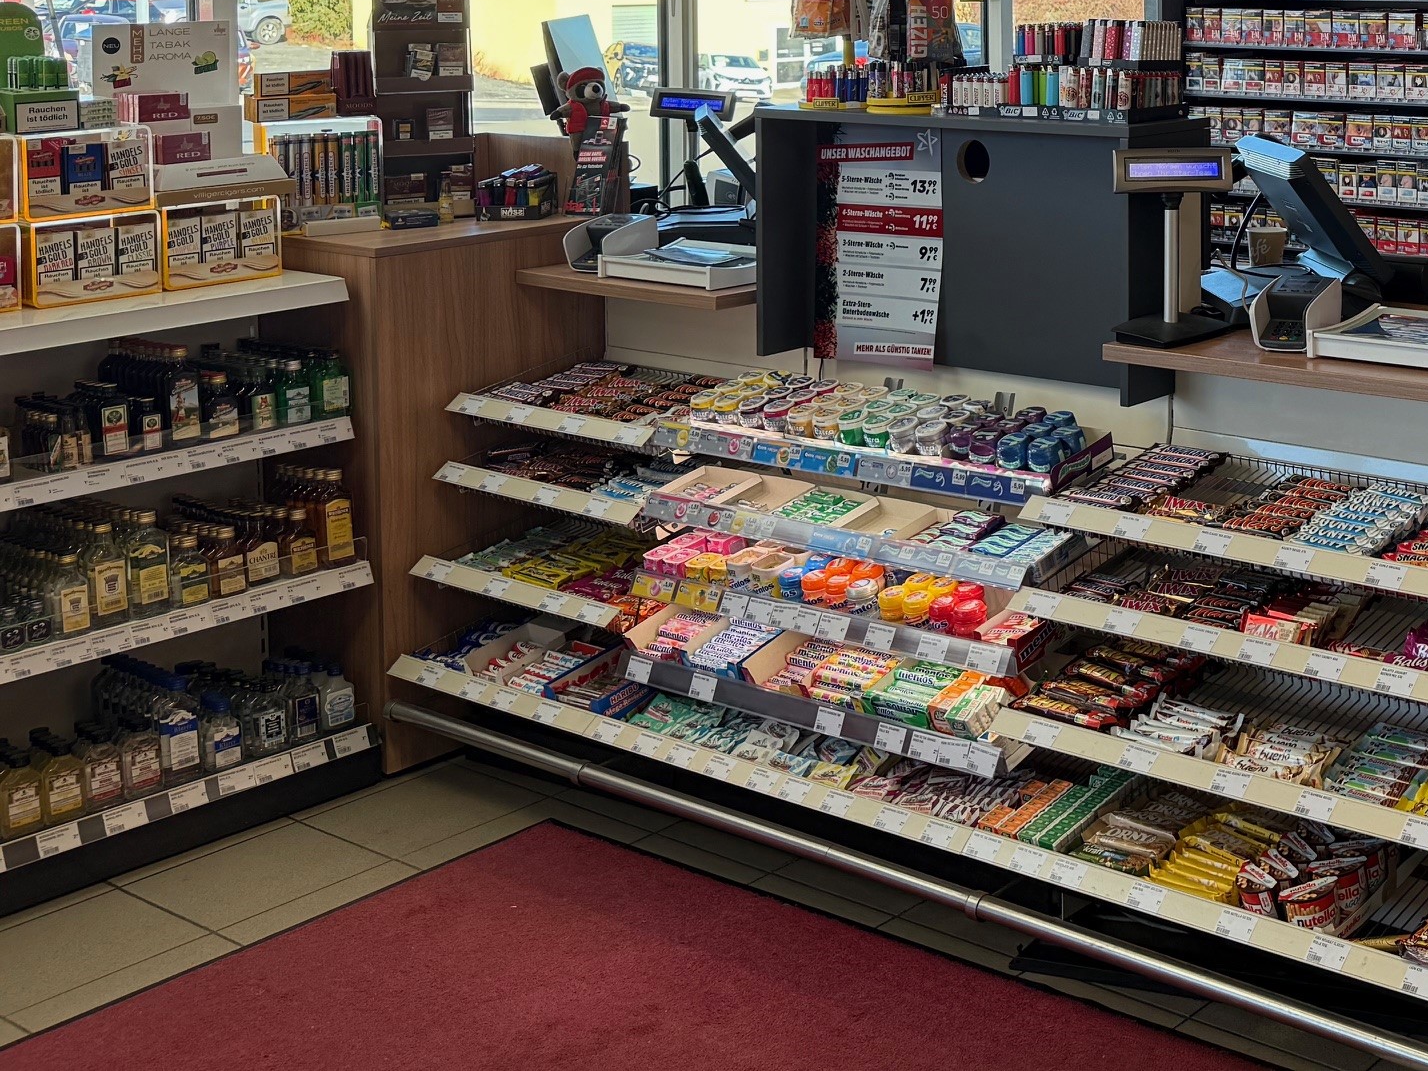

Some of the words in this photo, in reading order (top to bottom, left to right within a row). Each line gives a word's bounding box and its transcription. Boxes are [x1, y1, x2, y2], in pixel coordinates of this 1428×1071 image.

[378, 11, 409, 23] Meine
[410, 11, 433, 22] Zeit
[931, 6, 949, 19] 50
[149, 28, 191, 36] LANGE
[910, 5, 927, 58] GIZEH
[132, 30, 142, 62] MEHR
[149, 40, 191, 49] TABAK
[149, 52, 192, 60] AROMA
[910, 94, 935, 102] CLIPPER
[28, 105, 66, 114] Rauchen
[26, 114, 38, 122] ist
[39, 113, 68, 122] tödlich
[110, 145, 143, 162] HANDELS
[176, 150, 200, 159] RED
[821, 149, 846, 160] UNSER
[848, 146, 911, 158] WASCHANGEBOT
[841, 175, 882, 184] 5-Sterne-Wäsche
[193, 186, 265, 200] villigercigars.com
[842, 209, 883, 218] 4-Sterne-Wäsche
[204, 220, 235, 235] HANDELS
[242, 216, 273, 231] HANDELS
[120, 230, 154, 246] HANDELS
[168, 224, 199, 240] HANDELS
[38, 239, 72, 256] HANDELS
[80, 235, 113, 251] HANDELS
[843, 239, 883, 249] 3-Sterne-Wäsche
[842, 270, 884, 279] 2-Sterne-Wäsche
[842, 300, 872, 308] Extra-Stern-
[842, 308, 889, 318] Unterbodenwäsche
[856, 344, 874, 352] MEHR
[875, 344, 885, 352] ALS
[887, 344, 910, 354] GÜNSTIG
[911, 346, 931, 355] TANKEN!
[1368, 483, 1422, 499] BOUNTY
[1163, 496, 1205, 511] TWIX
[1120, 597, 1161, 612] TWIX
[659, 629, 690, 643] mentos
[898, 670, 935, 685] mentos
[610, 683, 639, 705] HARIBO
[1259, 750, 1290, 761] bueno
[1235, 760, 1268, 773] bueno
[1297, 908, 1336, 928] nutella
